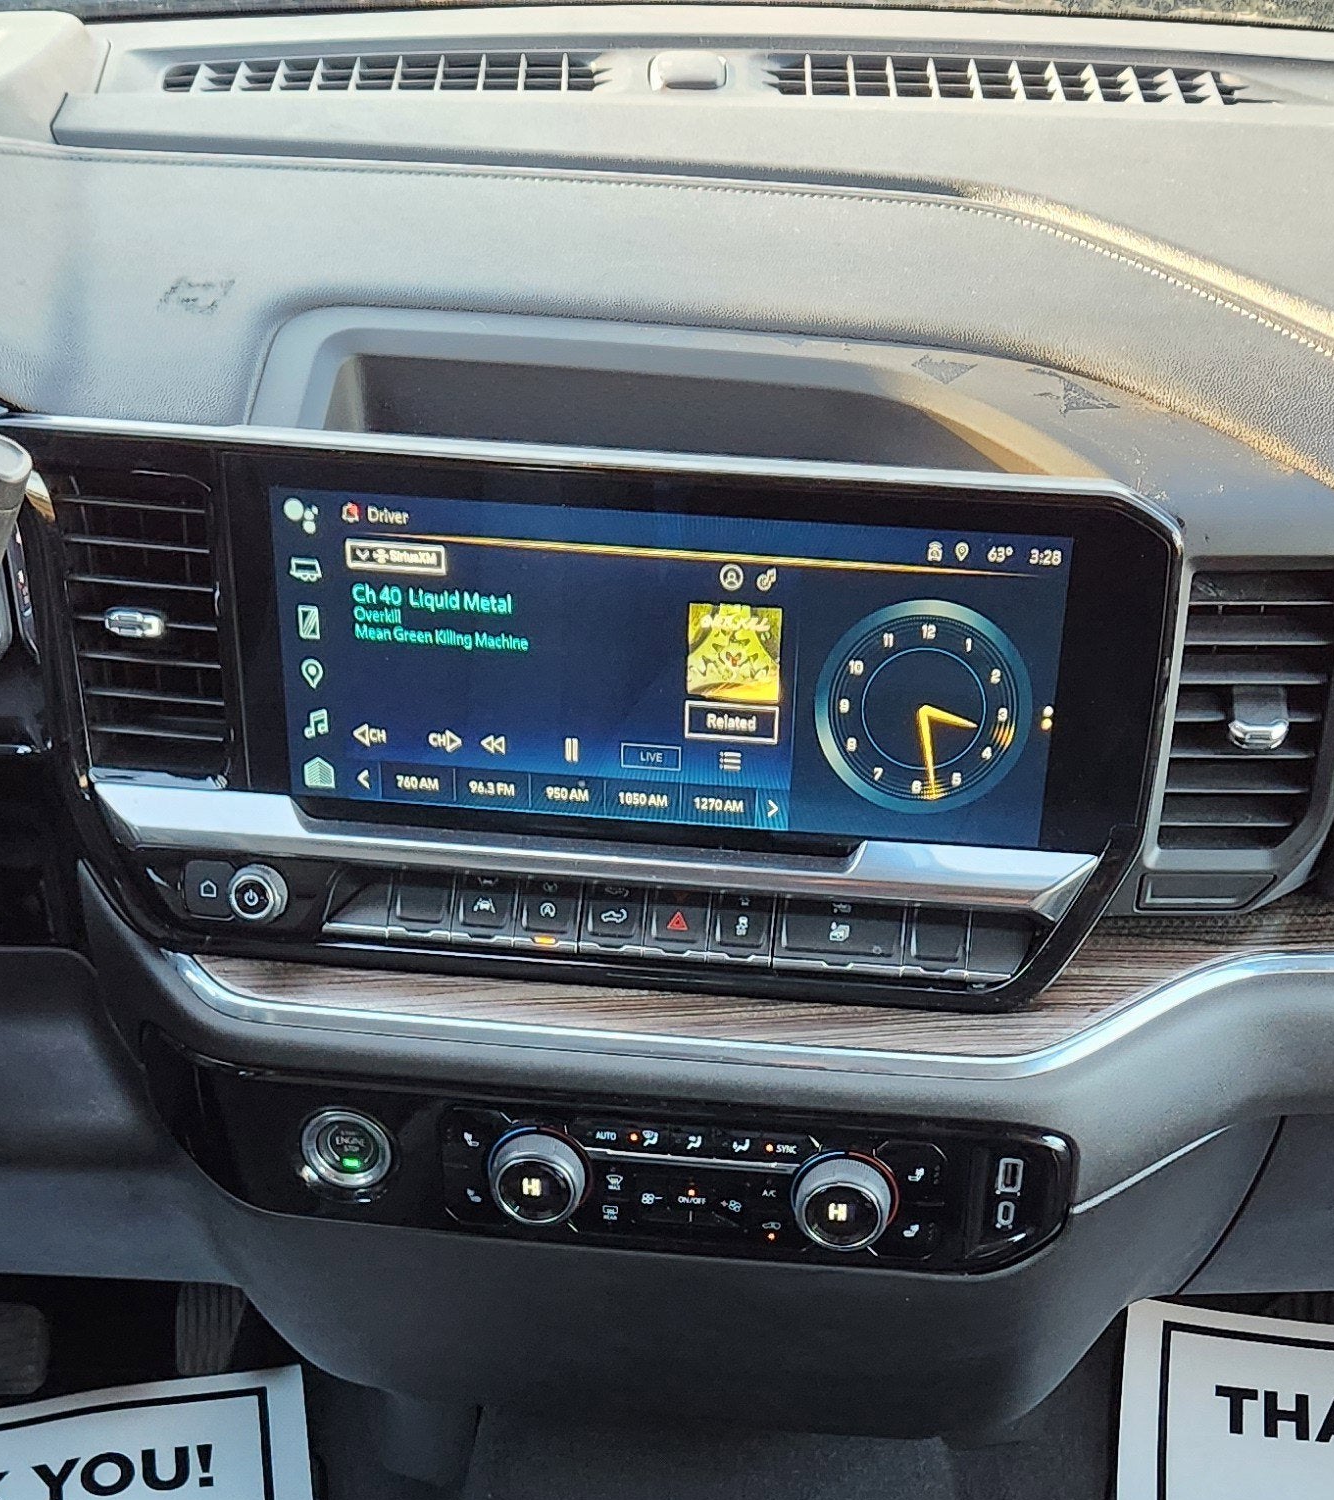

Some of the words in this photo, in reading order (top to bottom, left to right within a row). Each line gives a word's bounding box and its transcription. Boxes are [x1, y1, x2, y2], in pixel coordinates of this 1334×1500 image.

[367, 505, 409, 525] Driver
[389, 551, 438, 566] SiriusXM
[1029, 548, 1062, 566] 3:28
[351, 582, 377, 605] Ch
[379, 585, 402, 606] 40
[408, 587, 461, 613] Liquid
[463, 591, 513, 614] Metal
[353, 605, 402, 624] Overkill
[354, 623, 392, 641] Mean
[393, 625, 433, 644] Green
[434, 628, 473, 650] Killing
[474, 631, 529, 651] Machine
[883, 632, 894, 648] 11
[921, 624, 937, 640] 12
[965, 637, 972, 652] 1
[848, 659, 864, 676] 10
[990, 668, 1002, 684] 2
[839, 698, 850, 714] 9
[706, 713, 757, 732] Related
[997, 707, 1008, 722] 3
[370, 728, 387, 743] CH
[428, 732, 447, 747] CH
[639, 751, 663, 763] LIVE
[395, 774, 418, 789] 760
[419, 777, 440, 791] AM
[468, 780, 495, 795] 96.3
[496, 782, 515, 797] FM
[545, 786, 568, 800] 950
[568, 788, 589, 802] AM
[618, 791, 647, 805] 1050
[648, 793, 668, 807] AM
[693, 797, 723, 811] 1270
[724, 799, 744, 813] AM
[335, 1136, 365, 1148] ENGINE
[596, 1131, 617, 1141] AUTO
[775, 1143, 798, 1155] SYNC
[522, 1177, 542, 1197] HI
[762, 1188, 777, 1198] A/C
[677, 1196, 706, 1206] ON/OFF
[828, 1203, 847, 1222] HI
